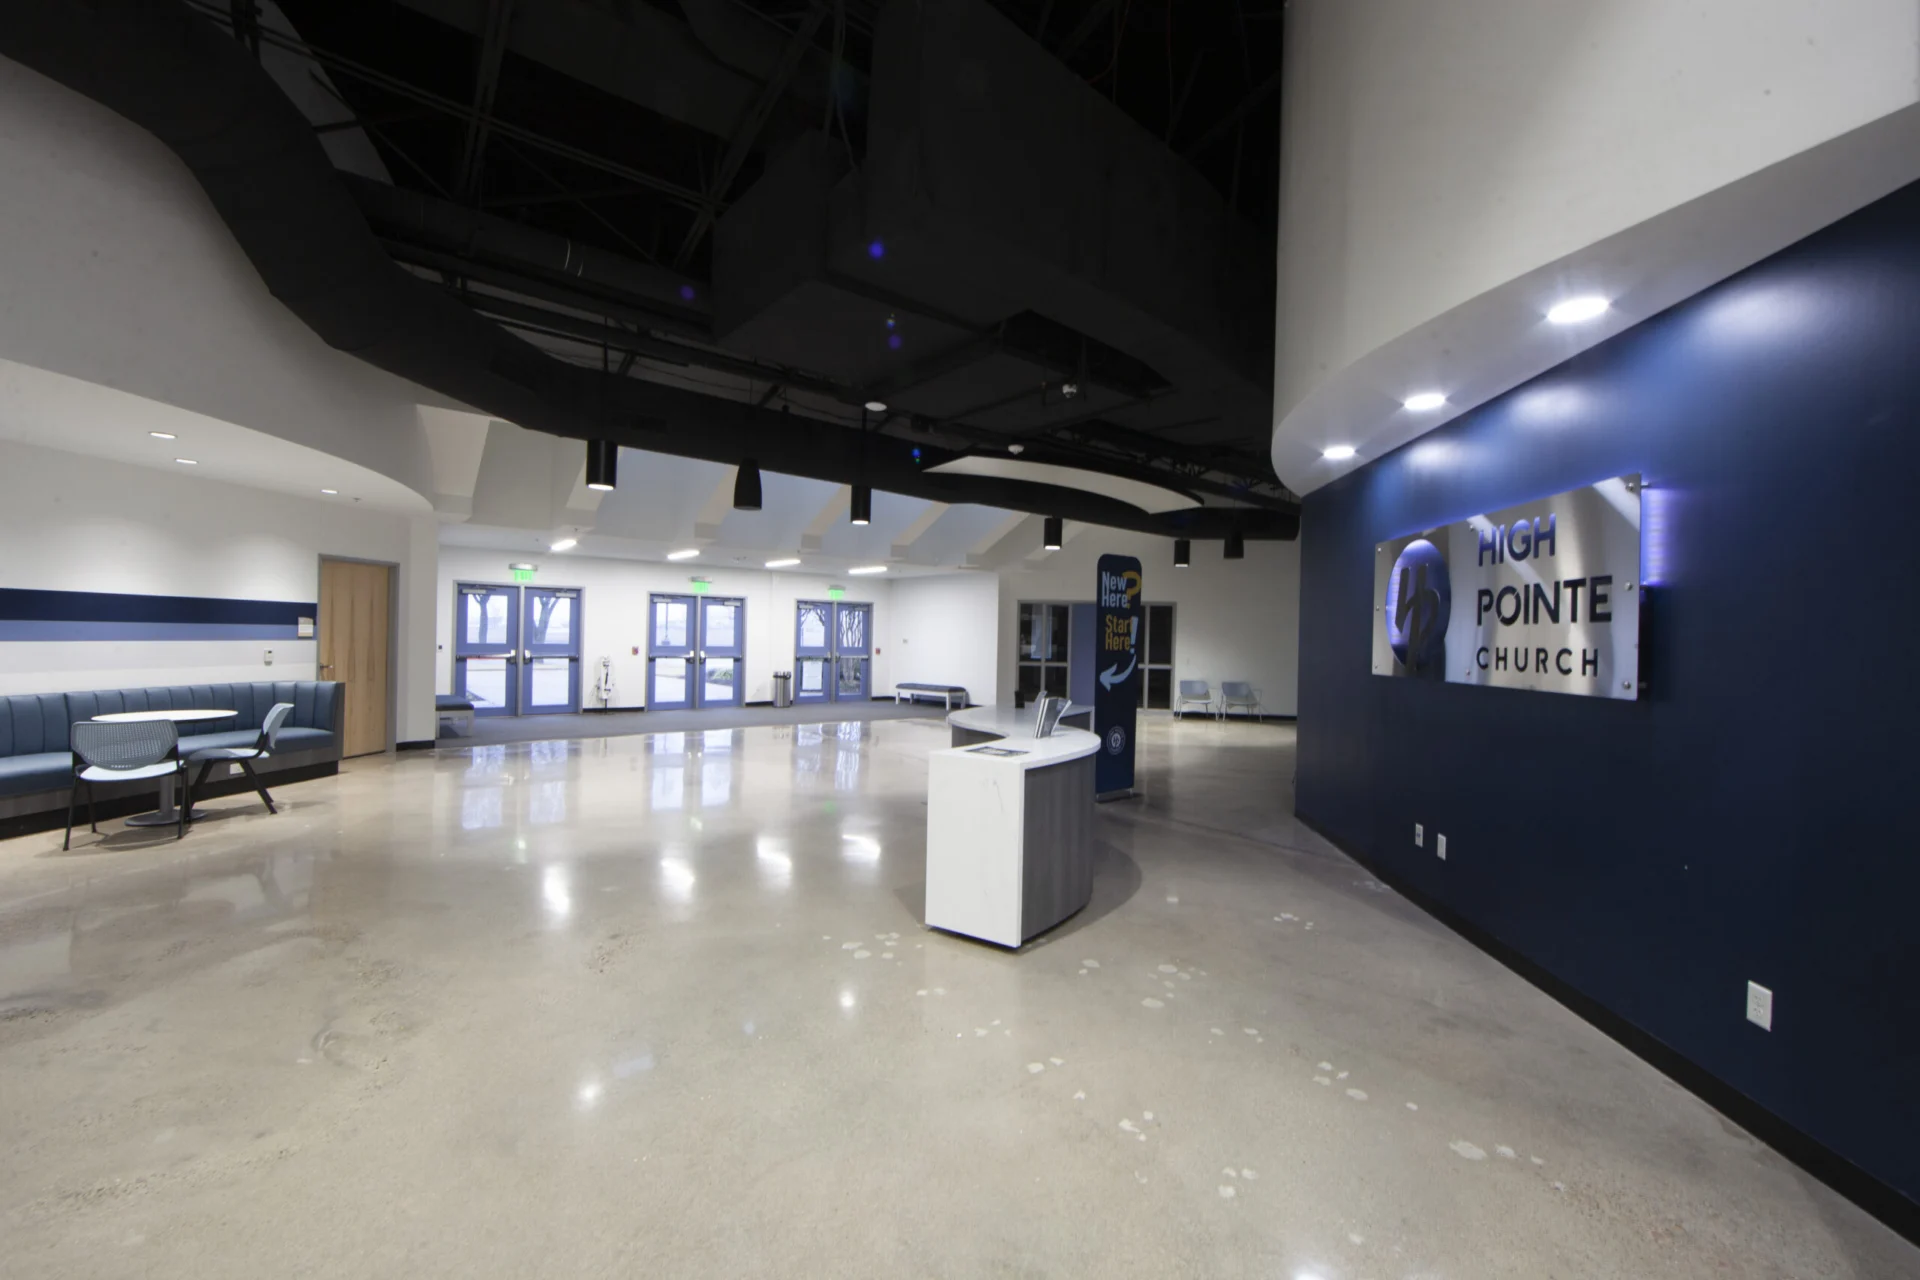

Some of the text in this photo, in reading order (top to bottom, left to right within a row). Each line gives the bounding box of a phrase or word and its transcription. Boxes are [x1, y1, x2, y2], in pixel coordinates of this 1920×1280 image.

[1478, 513, 1556, 567] HIGH
[1101, 570, 1128, 591] New
[1477, 575, 1613, 626] POINTE
[1476, 647, 1598, 677] CHURCH
